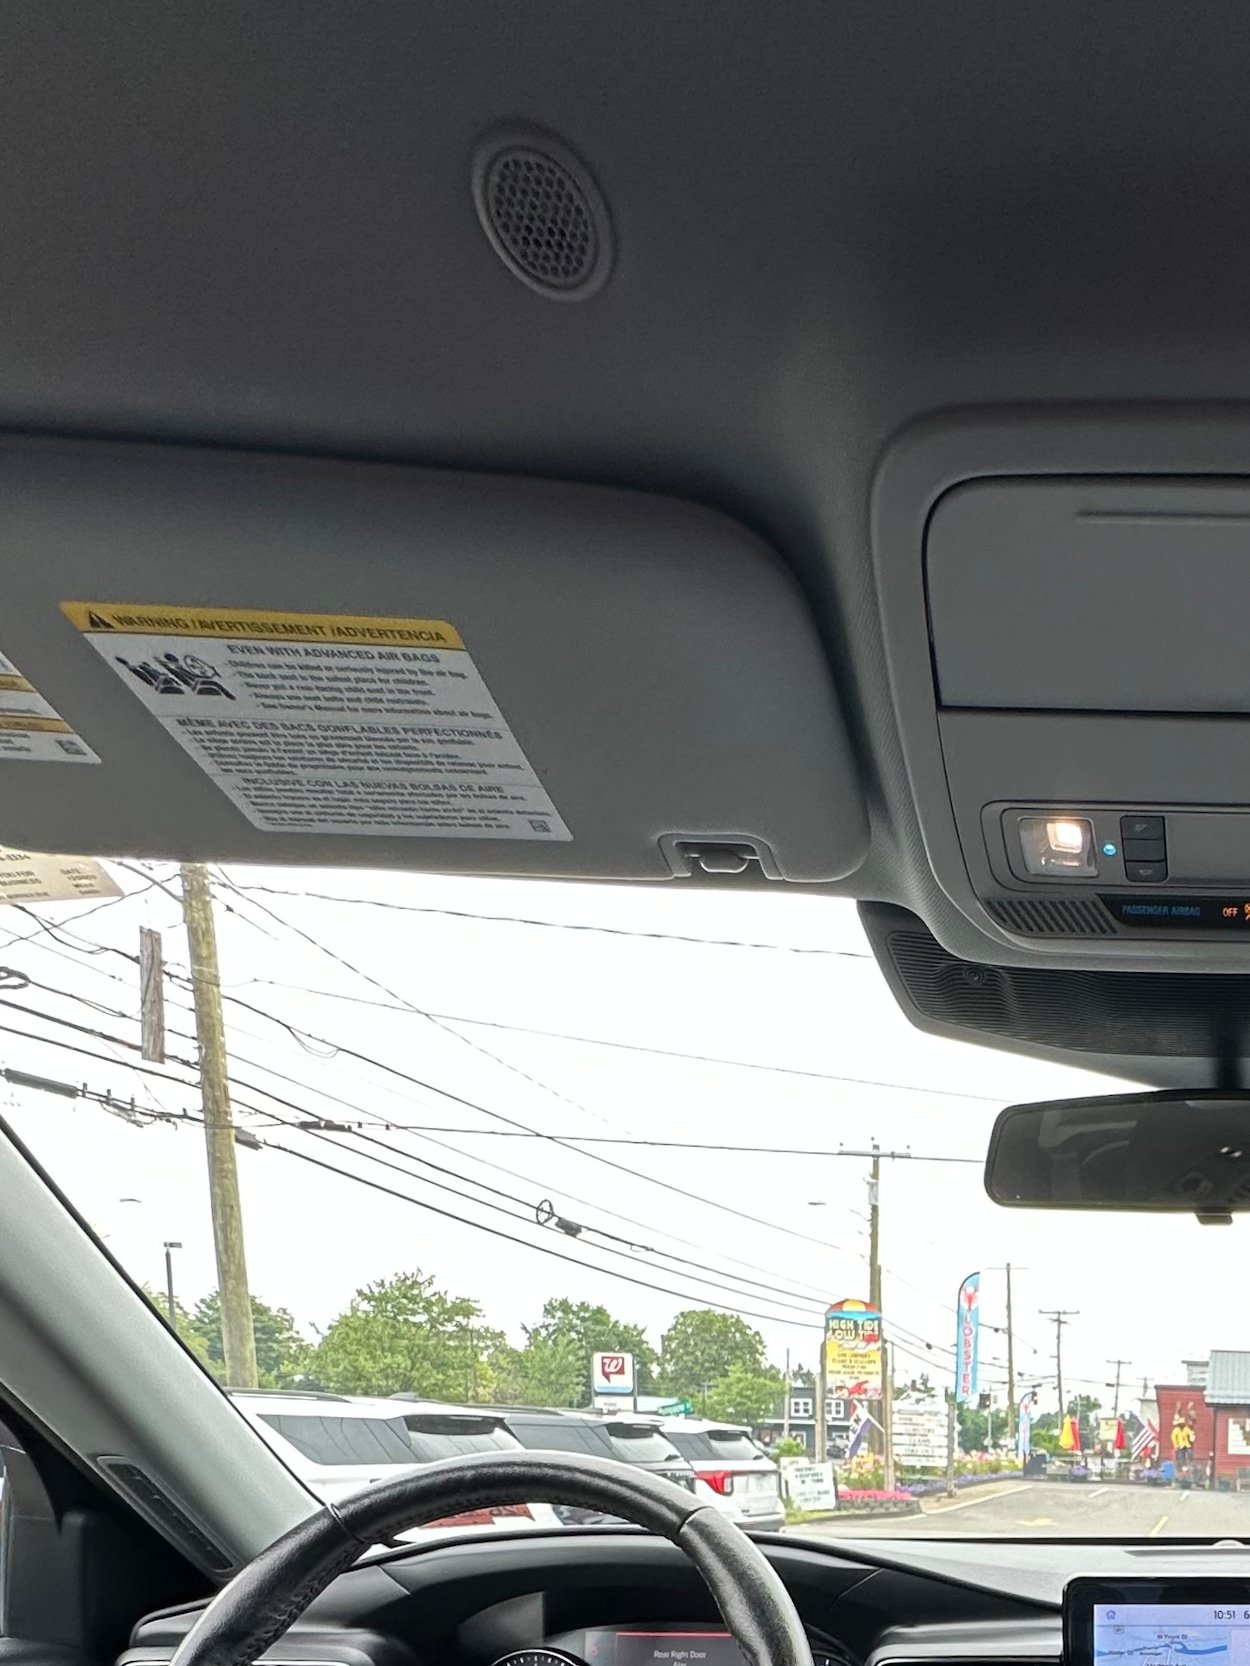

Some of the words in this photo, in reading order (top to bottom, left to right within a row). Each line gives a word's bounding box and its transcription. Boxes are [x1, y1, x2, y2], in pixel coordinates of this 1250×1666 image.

[112, 615, 189, 628] WARNING
[226, 645, 264, 655] EVEN
[267, 647, 300, 657] WITH
[304, 649, 375, 660] ADVANCED
[378, 652, 400, 661] AIR
[402, 653, 440, 663] BAGS
[218, 719, 250, 729] AVEC
[306, 779, 333, 788] CON
[334, 780, 359, 789] LAS
[459, 784, 475, 792] DE
[1122, 904, 1169, 915] PASSENGER
[1171, 904, 1200, 916] AIRBAG
[1222, 907, 1239, 917] OFF
[829, 1319, 854, 1330] HIGH
[961, 1313, 974, 1397] LOBSTER
[1214, 1610, 1236, 1620] 10:51
[654, 1650, 670, 1658] Rear
[671, 1650, 688, 1660] Right
[690, 1650, 706, 1659] Door
